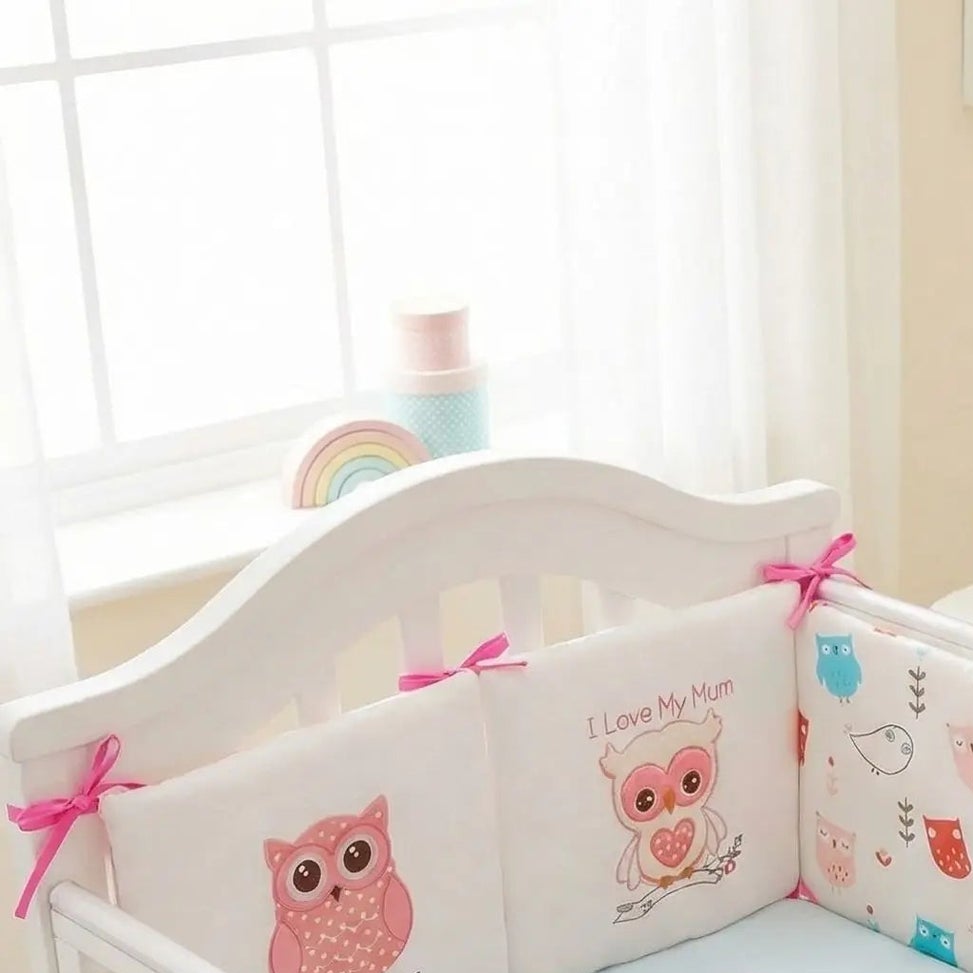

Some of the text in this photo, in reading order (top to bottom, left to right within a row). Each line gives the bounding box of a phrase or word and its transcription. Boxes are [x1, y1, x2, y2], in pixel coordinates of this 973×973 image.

[587, 679, 734, 739] I Love My Mum
